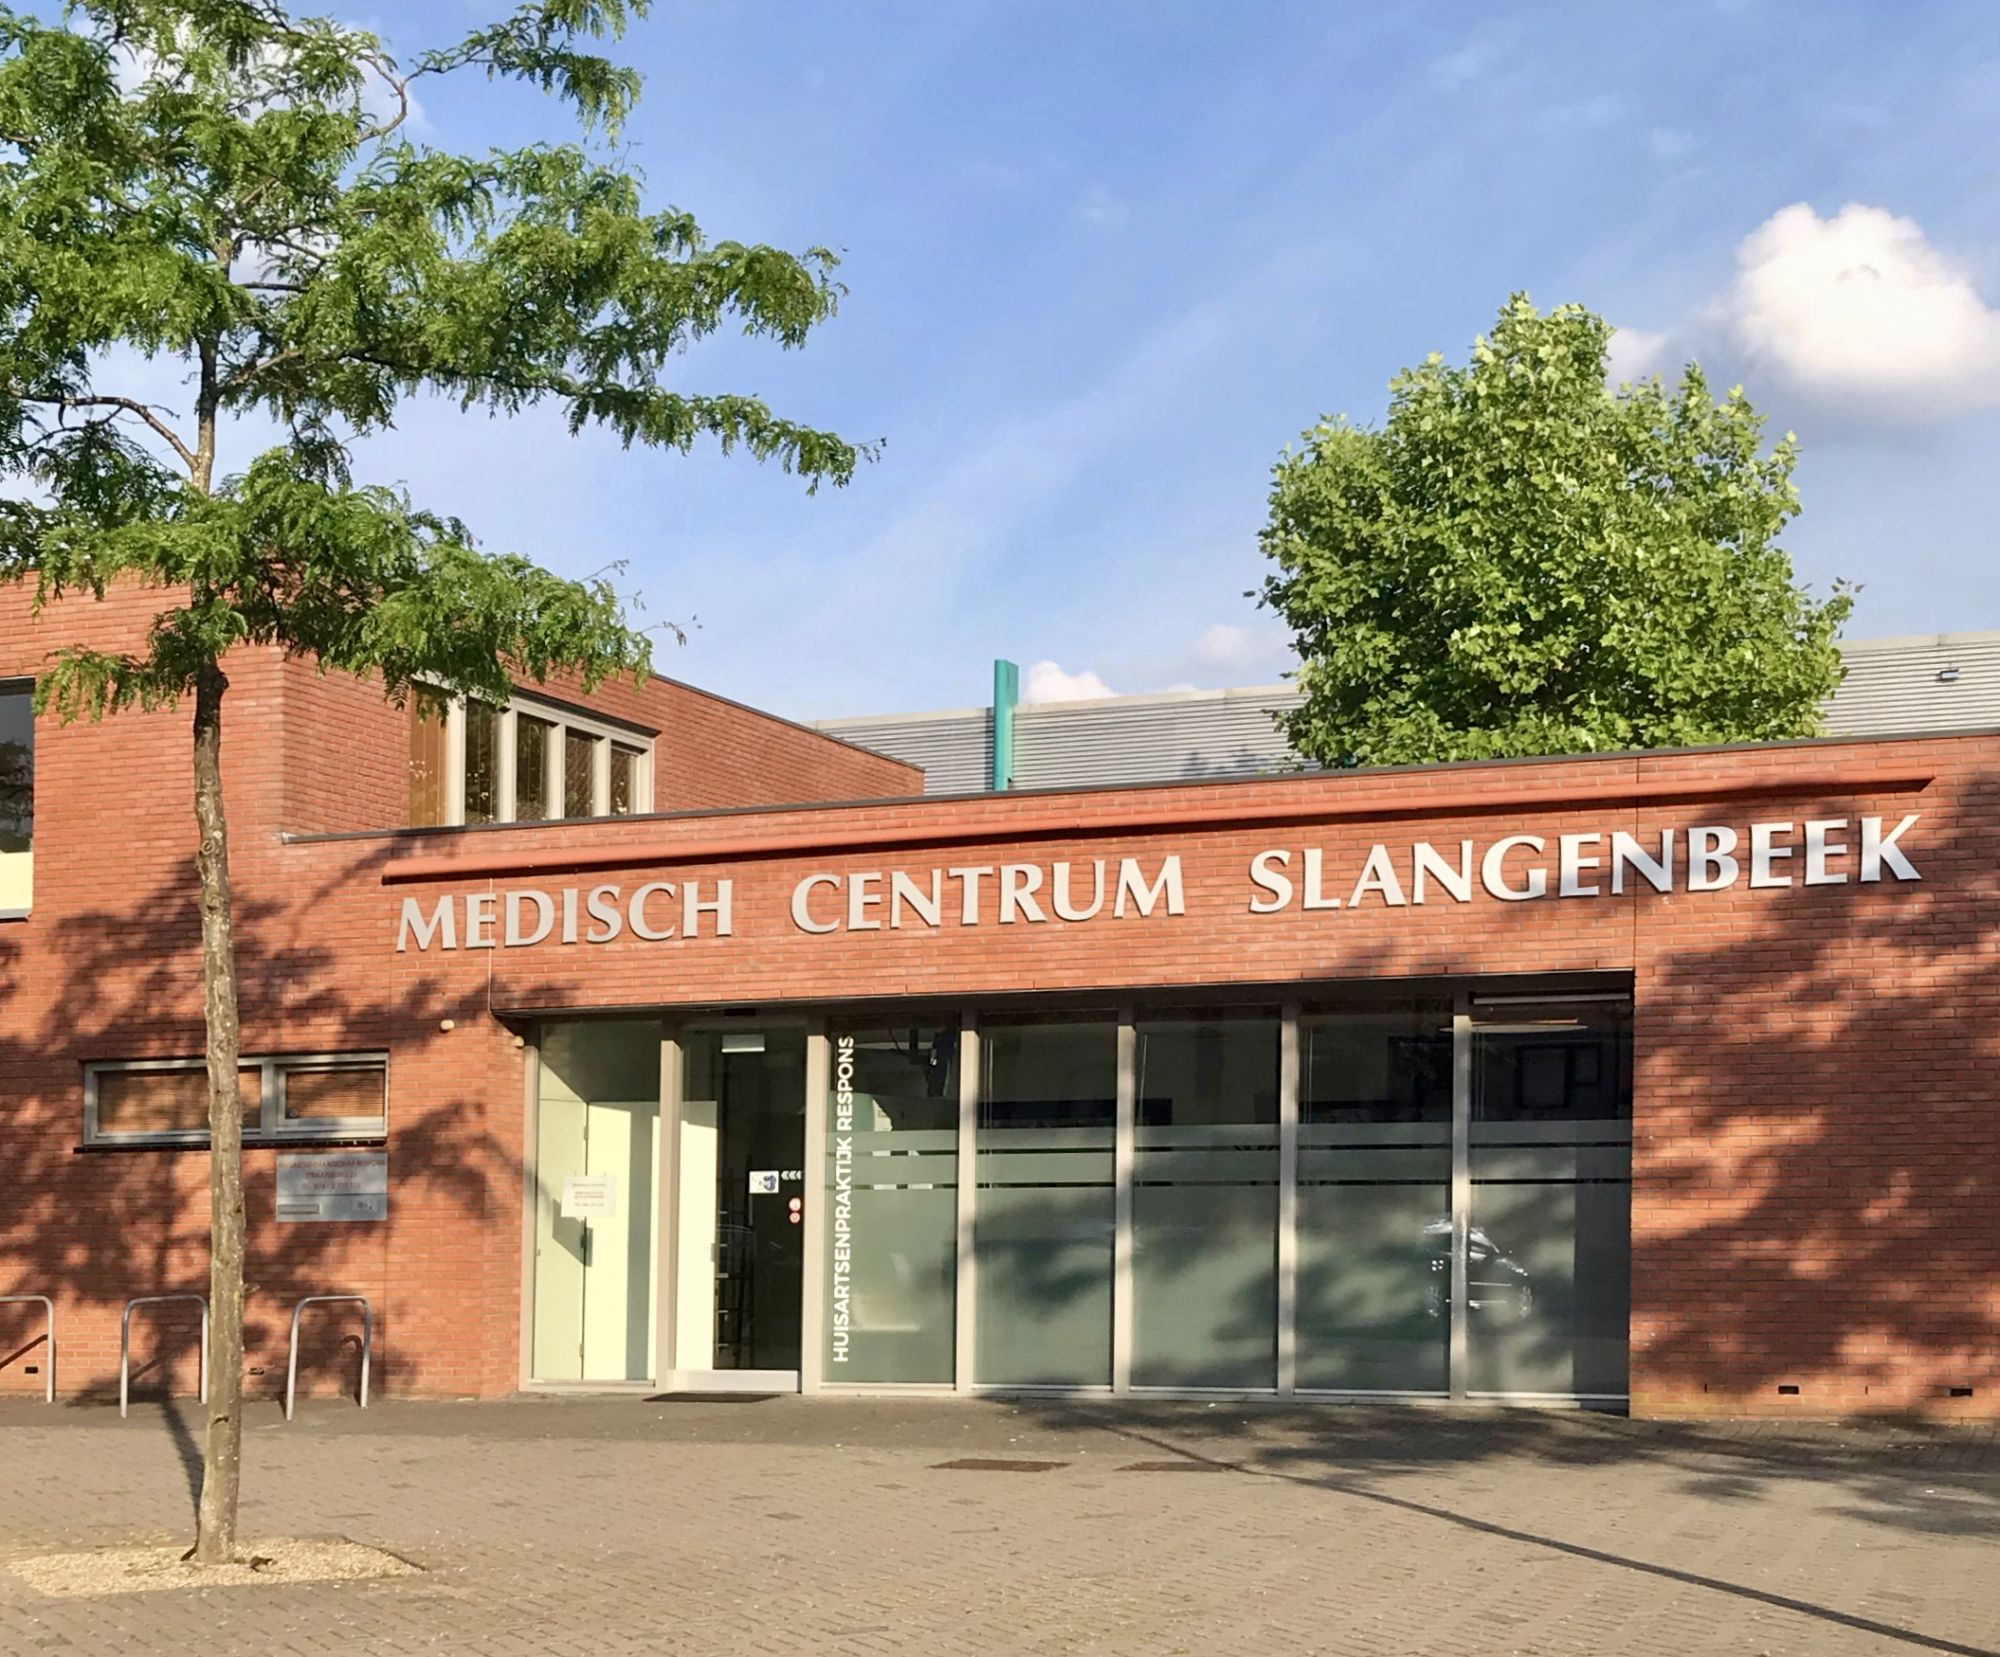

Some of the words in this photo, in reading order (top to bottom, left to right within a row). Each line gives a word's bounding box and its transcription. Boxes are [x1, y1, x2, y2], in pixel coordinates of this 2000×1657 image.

[396, 879, 733, 952] MEDISCH
[790, 855, 1185, 934] CENTRUM
[1249, 814, 1922, 914] SLANGENBEEK
[836, 1036, 854, 1131] RESPONS
[833, 1137, 852, 1363] HUISARTSENPRAKTIJK
